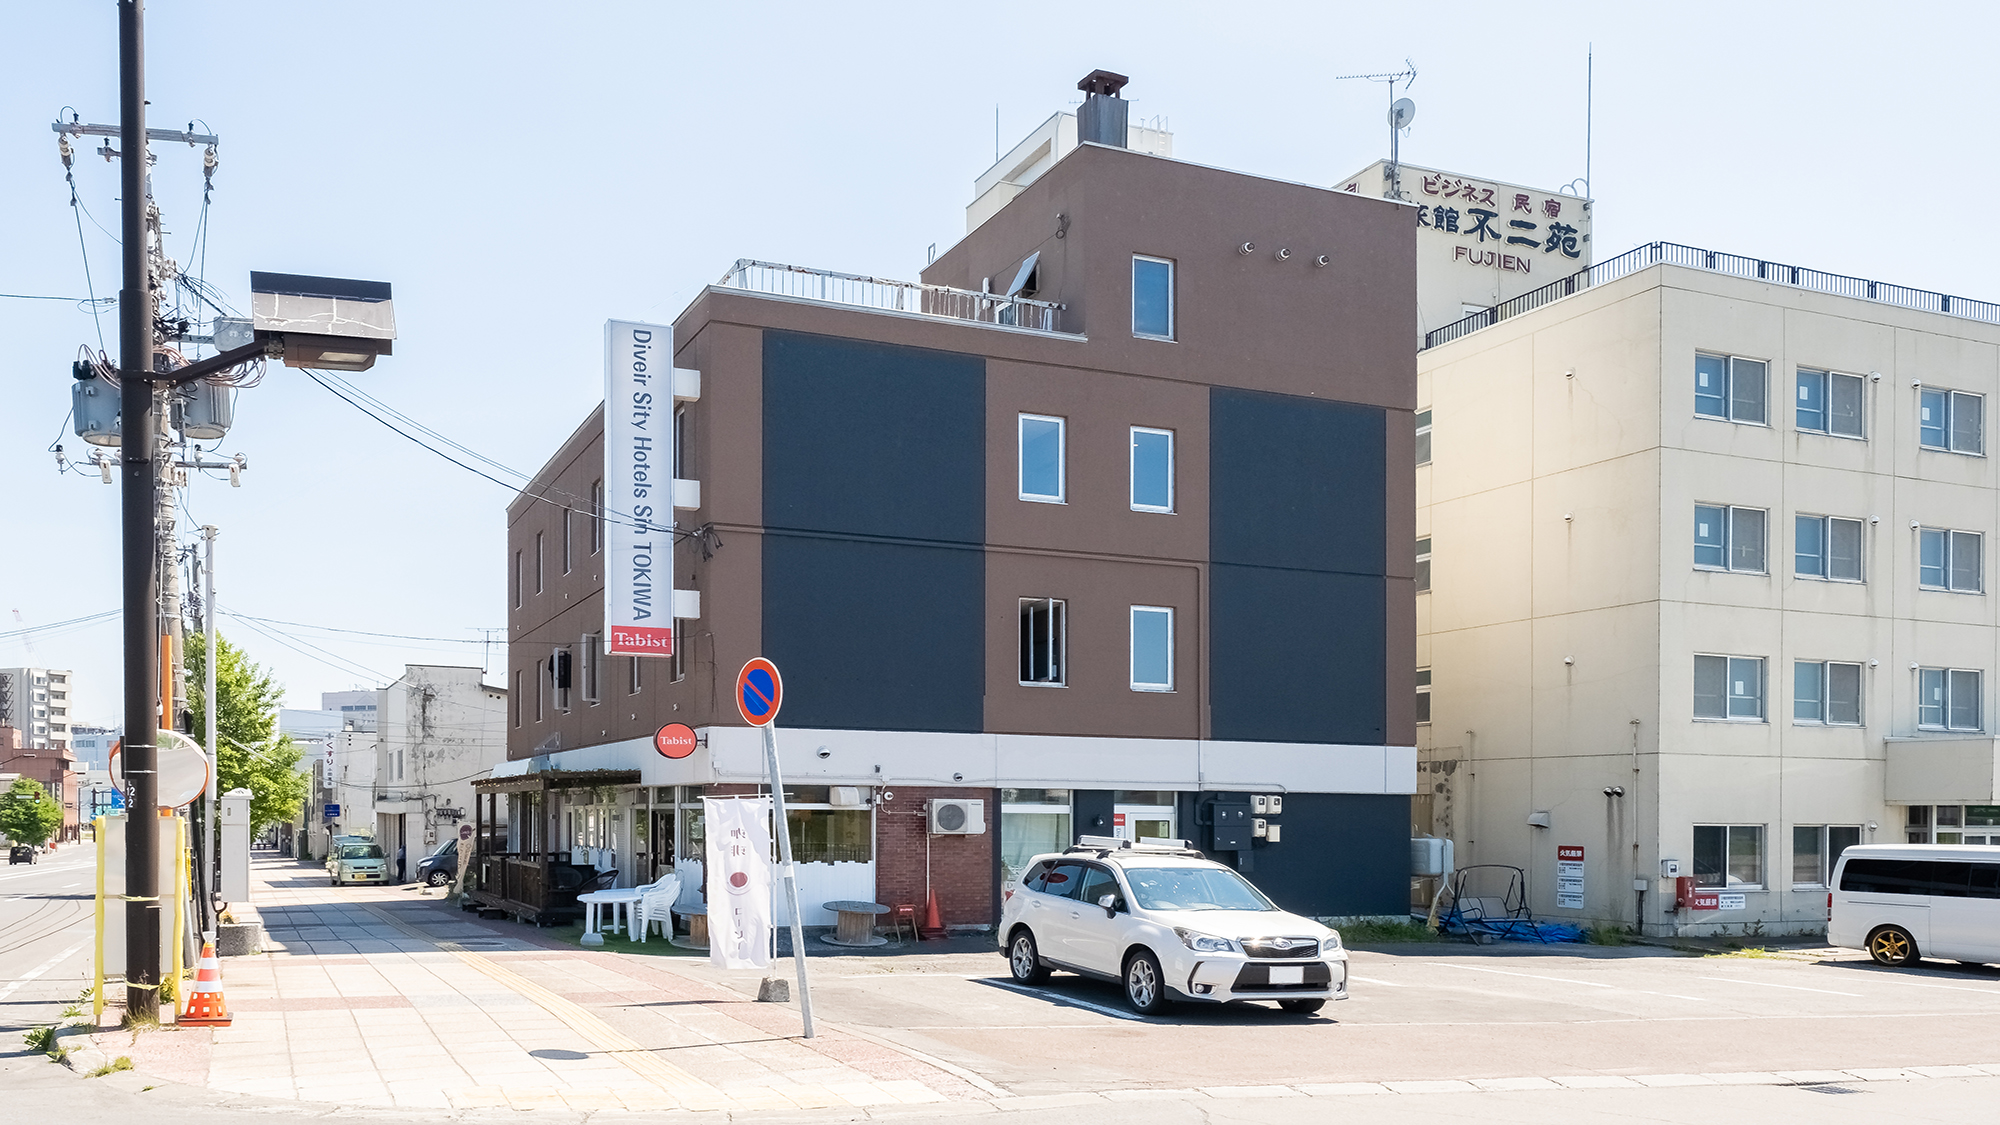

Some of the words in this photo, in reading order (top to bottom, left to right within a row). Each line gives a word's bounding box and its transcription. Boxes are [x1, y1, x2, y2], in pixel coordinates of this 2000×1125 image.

[1420, 173, 1496, 208] ビジネス
[1512, 193, 1562, 219] 民宿
[1453, 245, 1531, 274] FUJIEN
[632, 329, 652, 387] Diveir
[631, 391, 653, 431] Sity
[633, 436, 653, 498] Hotels
[633, 504, 653, 534] Sin
[632, 541, 652, 621] TOKIWA
[613, 632, 668, 648] Tabist
[325, 741, 335, 766] くすり
[659, 736, 692, 745] Tabist
[126, 786, 136, 796] 12
